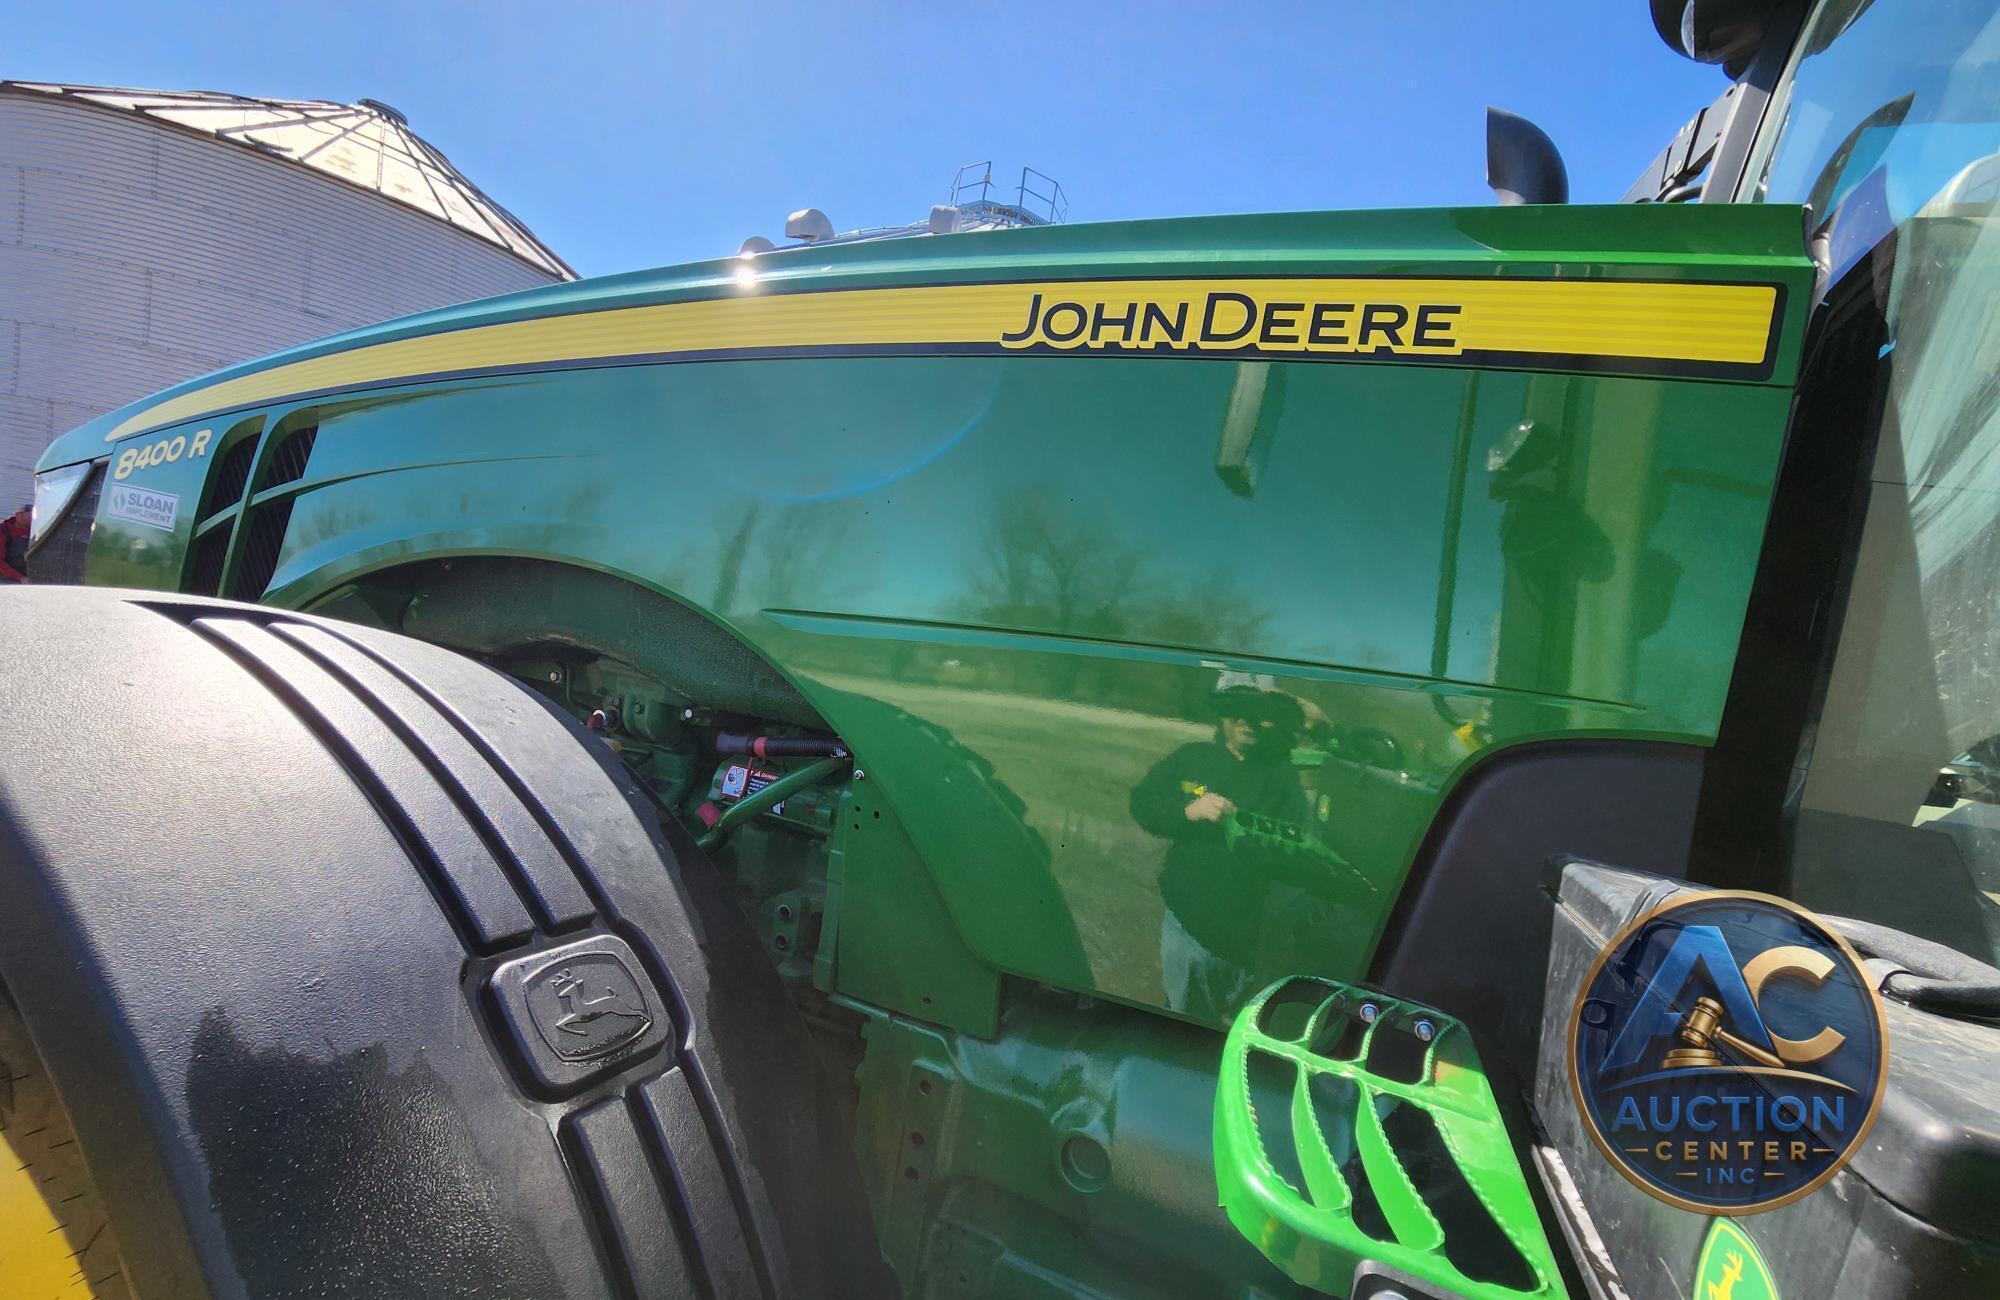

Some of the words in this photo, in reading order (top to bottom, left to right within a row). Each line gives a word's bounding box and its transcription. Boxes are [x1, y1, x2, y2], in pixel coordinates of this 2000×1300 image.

[1001, 293, 1189, 343] JOHN
[1201, 292, 1462, 348] DEERE
[114, 435, 186, 480] 8400
[188, 429, 212, 459] R
[127, 493, 174, 515] SLOAN
